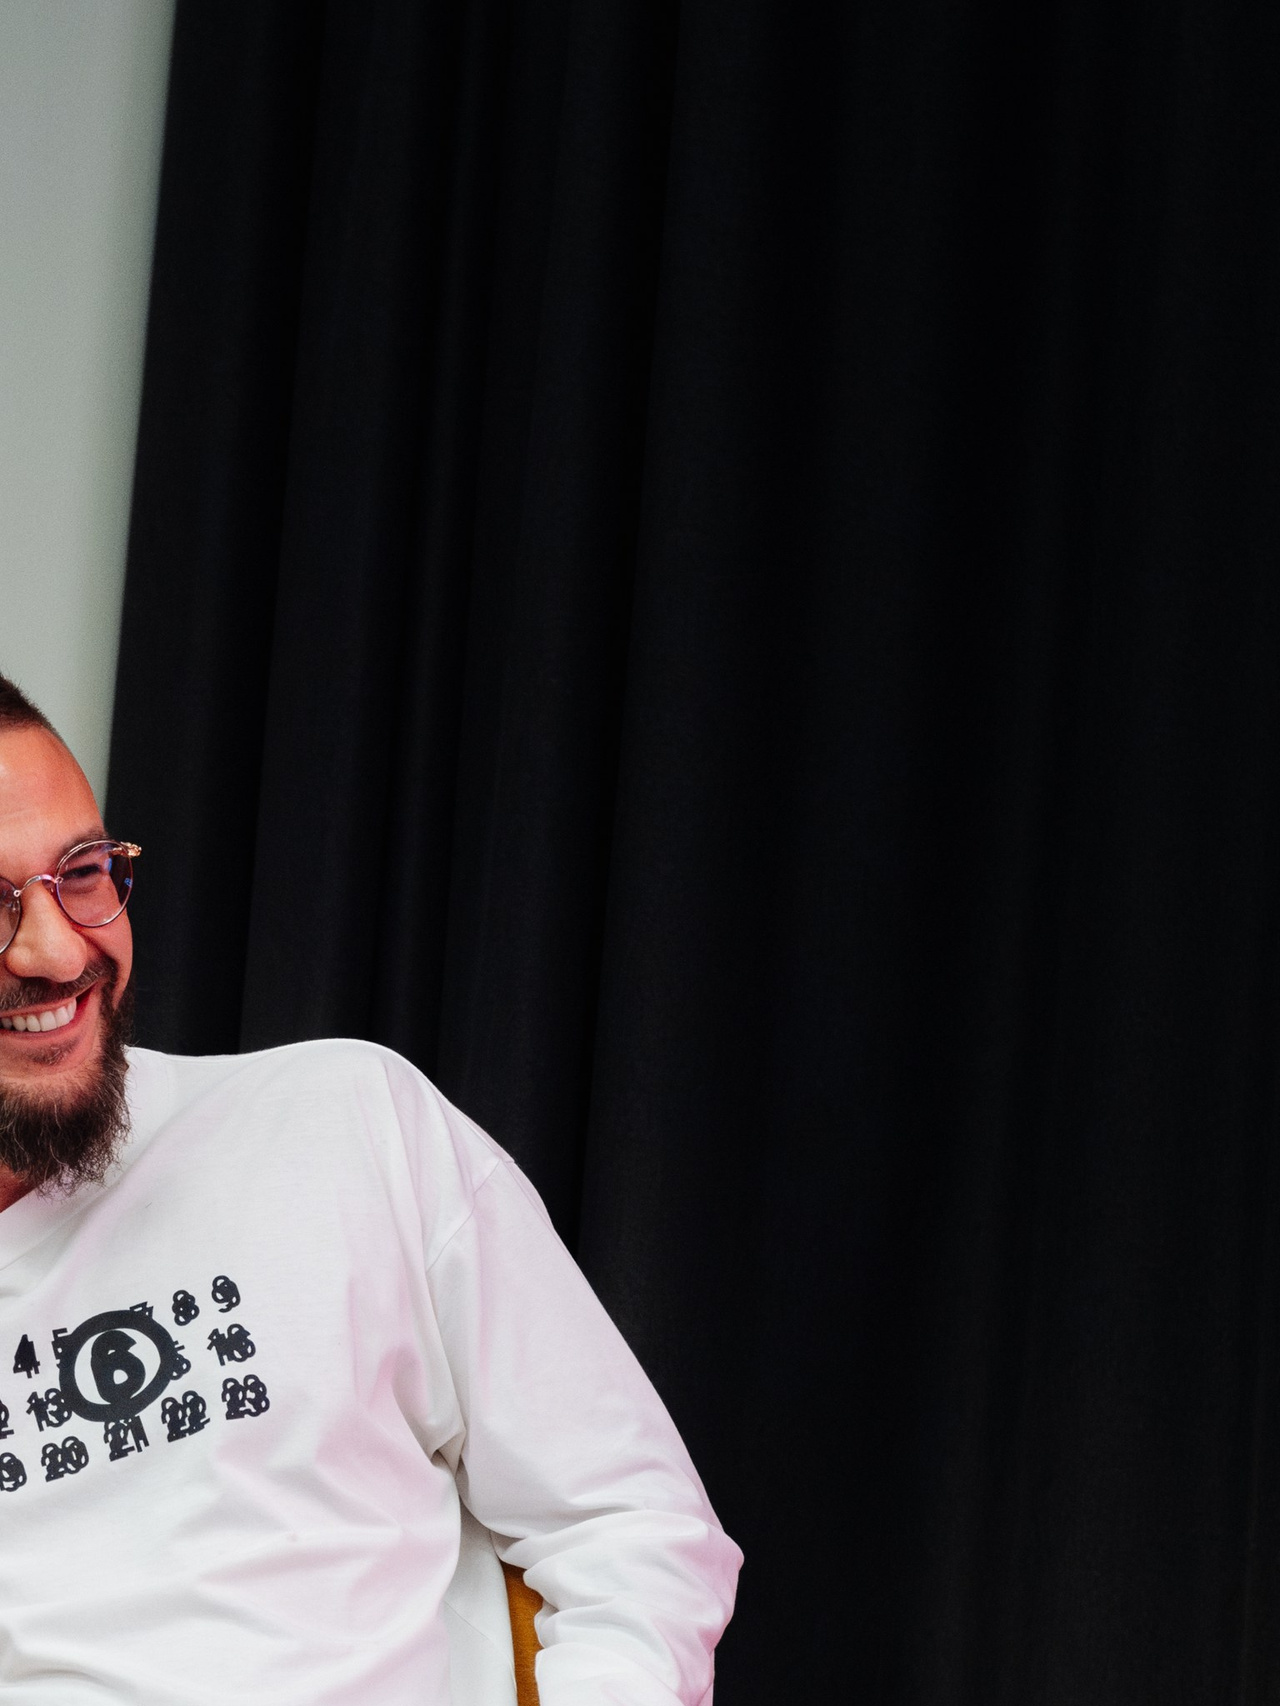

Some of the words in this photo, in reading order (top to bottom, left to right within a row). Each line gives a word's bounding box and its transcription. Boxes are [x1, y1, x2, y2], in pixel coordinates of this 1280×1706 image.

[13, 1334, 40, 1379] 4
[90, 1330, 146, 1404] 6
[172, 1290, 199, 1326] 8
[212, 1275, 241, 1312] 9
[26, 1388, 72, 1432] 13
[41, 1436, 89, 1482] 20
[104, 1416, 149, 1461] 21
[161, 1390, 210, 1442] 22
[221, 1374, 270, 1420] 23
